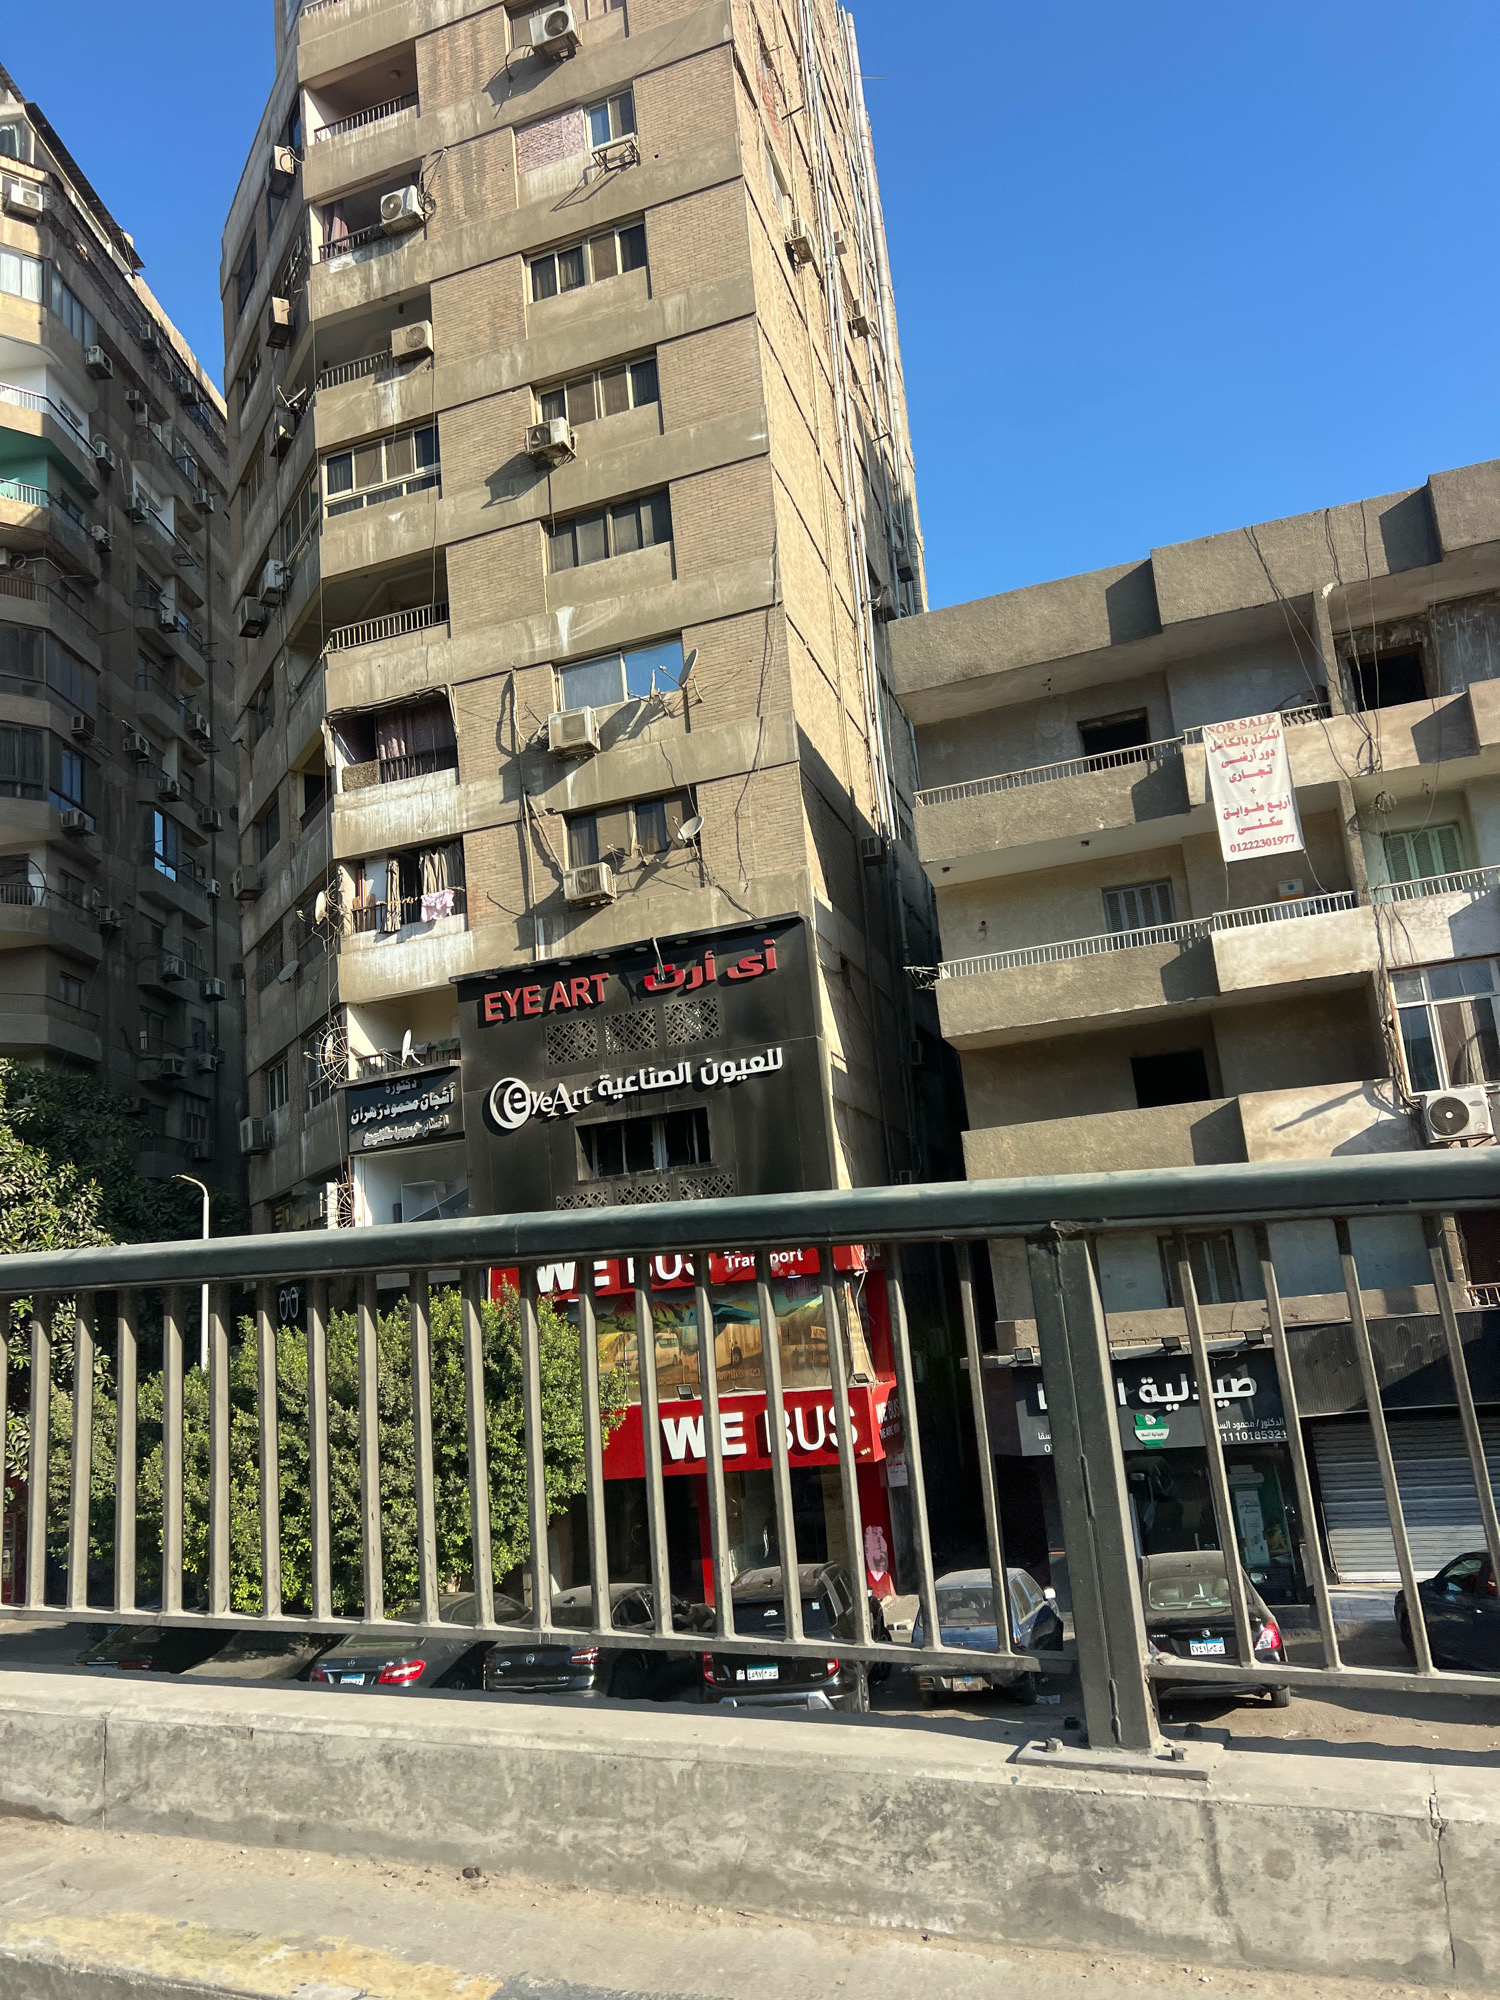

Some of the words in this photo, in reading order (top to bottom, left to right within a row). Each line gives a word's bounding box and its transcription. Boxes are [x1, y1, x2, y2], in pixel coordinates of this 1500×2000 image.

[1207, 722, 1237, 735] FOR
[1240, 714, 1277, 730] SALE
[1210, 735, 1249, 753] بالكامل
[1251, 729, 1280, 745] المنزل
[1259, 748, 1275, 761] دور
[1223, 801, 1265, 820] طوابق
[1267, 795, 1291, 813] أربع
[1230, 834, 1296, 853] 01222301977
[644, 950, 717, 991] أرت
[484, 984, 543, 1022] EYE
[548, 973, 610, 1011] ART
[700, 1047, 783, 1085] للعيون
[386, 1079, 417, 1095] دكتورة
[597, 1061, 693, 1100] الصناعية
[351, 1103, 384, 1125] زهران
[384, 1099, 420, 1118] محمود
[1233, 1421, 1254, 1430] محمود
[661, 1411, 747, 1460] WE
